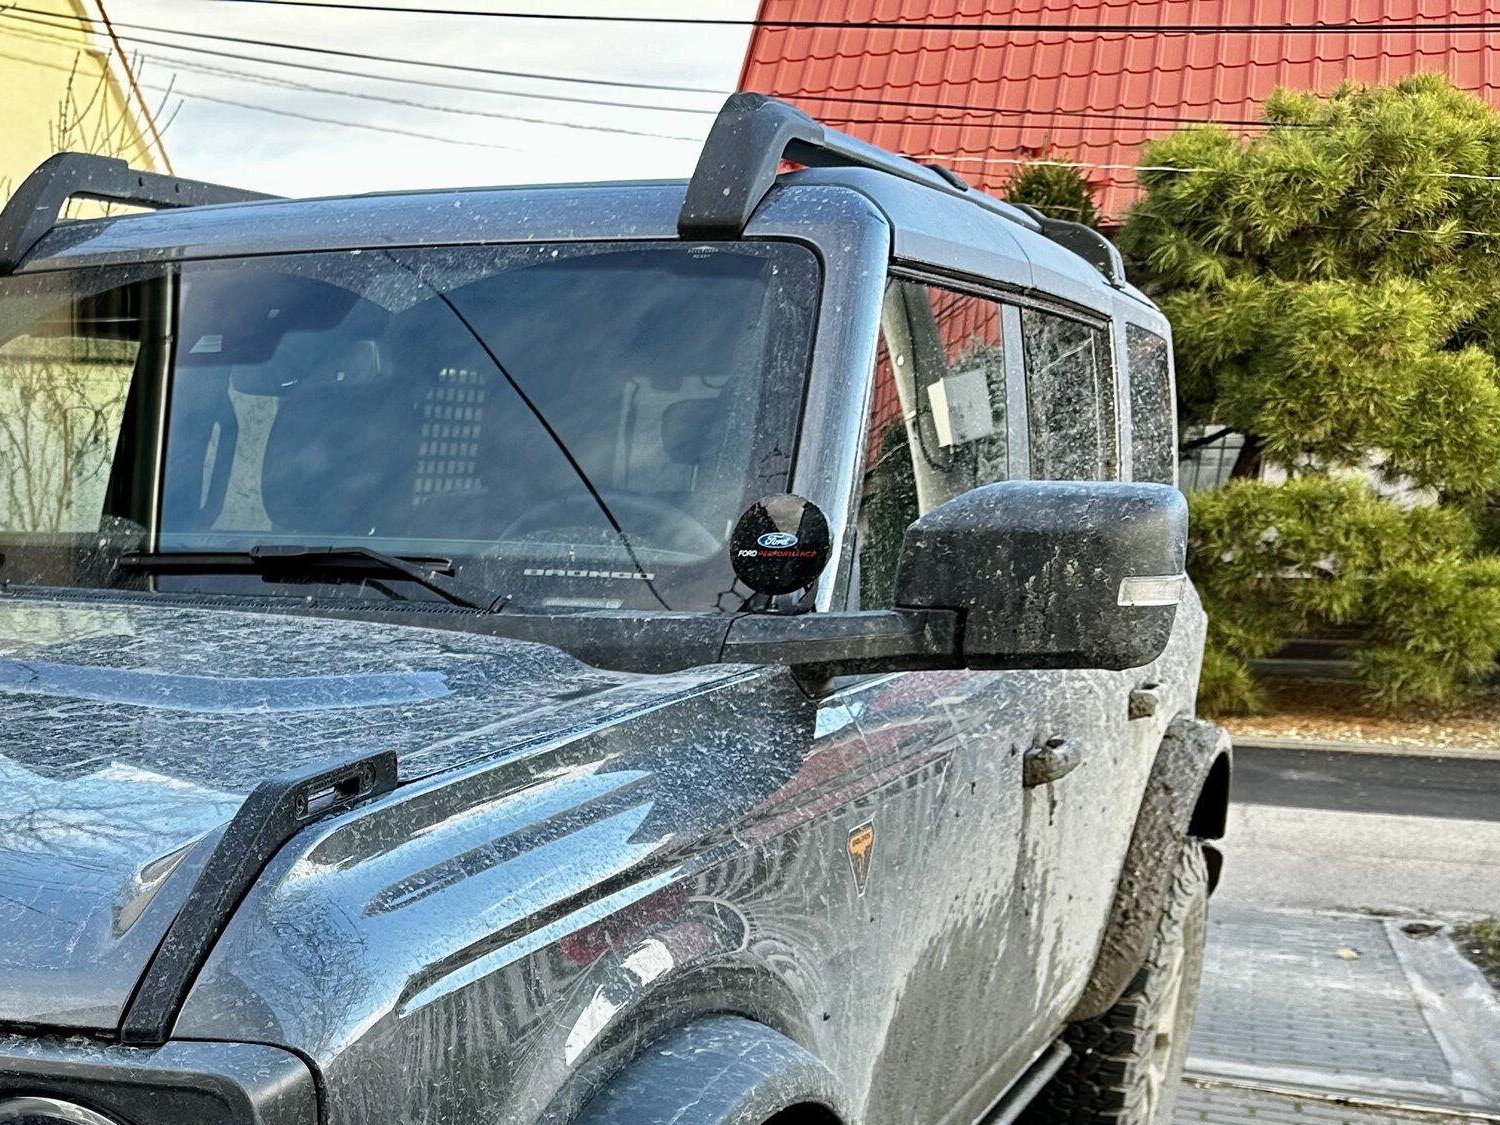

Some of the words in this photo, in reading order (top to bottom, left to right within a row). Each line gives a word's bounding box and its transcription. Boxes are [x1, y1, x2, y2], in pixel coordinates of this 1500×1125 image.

[763, 533, 792, 546] Ford
[738, 549, 758, 557] FORD
[758, 549, 817, 558] PERFORMANCE
[523, 568, 655, 581] BRONCO
